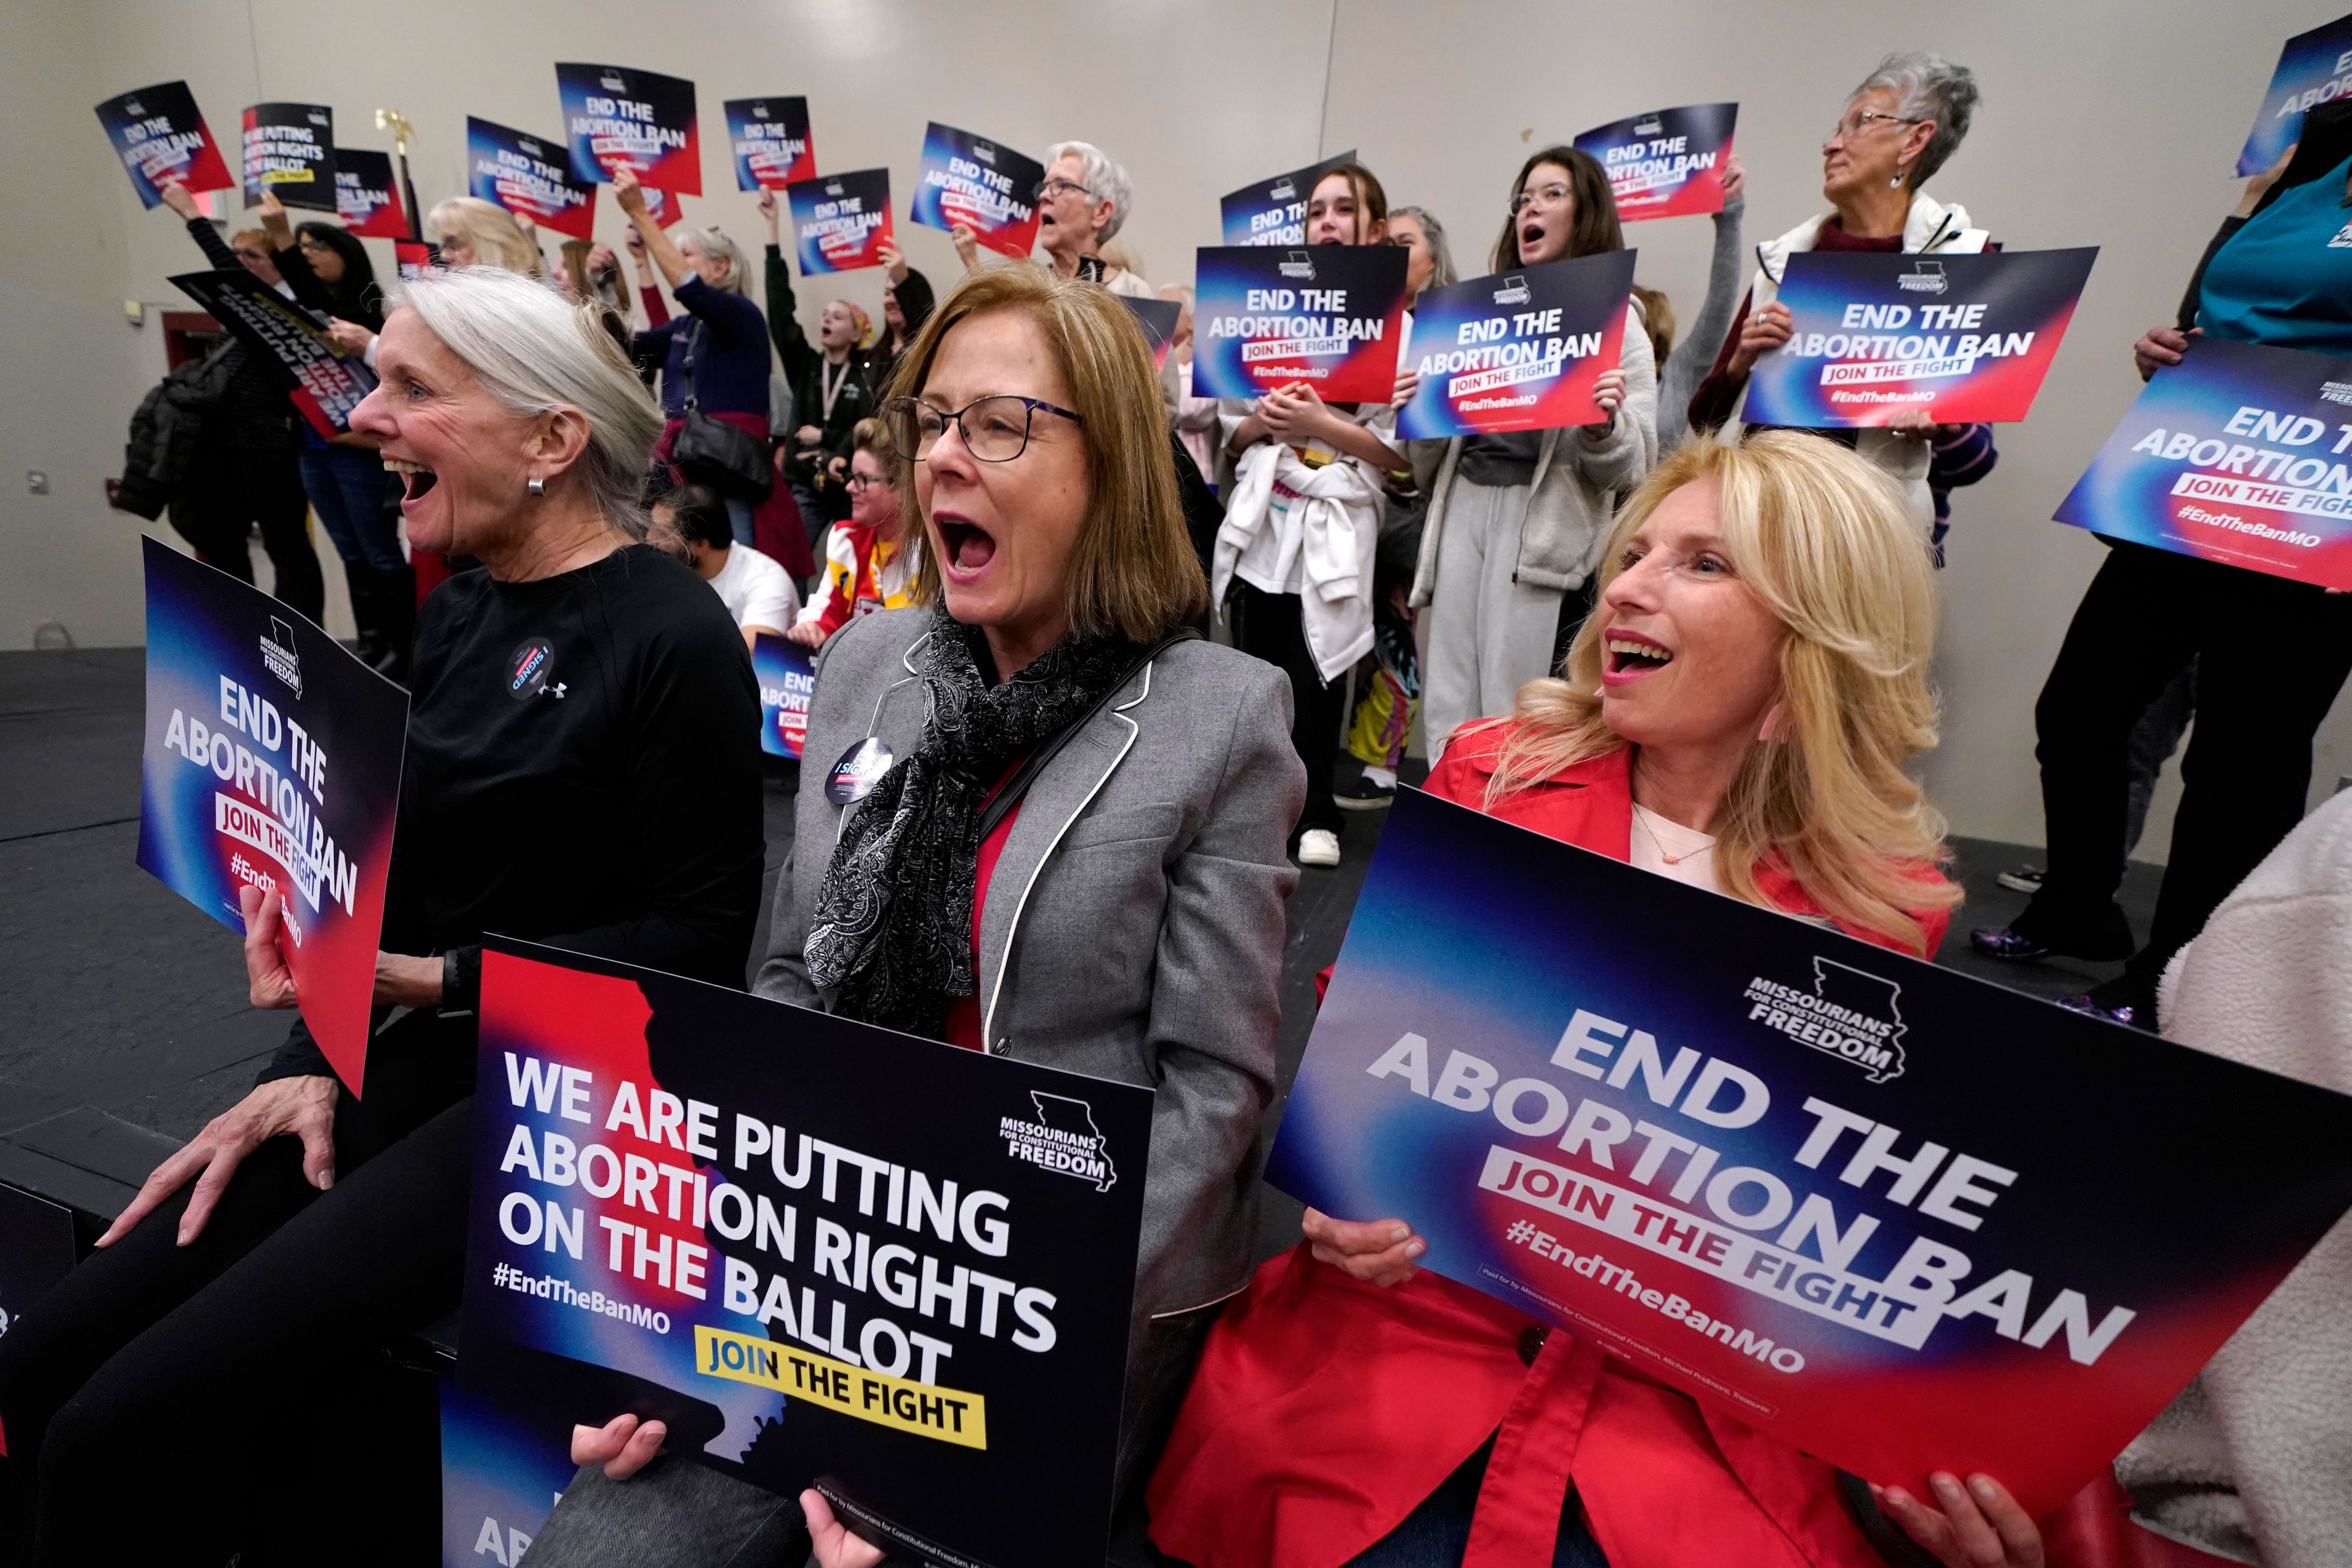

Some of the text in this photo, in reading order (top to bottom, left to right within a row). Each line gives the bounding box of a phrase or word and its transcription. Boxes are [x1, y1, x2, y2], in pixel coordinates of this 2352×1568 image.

[586, 97, 654, 123] END THE
[169, 130, 205, 151] BAN
[572, 117, 686, 149] ABORTION BAN
[764, 123, 786, 138] THE
[780, 139, 806, 154] BAN
[497, 149, 564, 183] END THE
[1607, 137, 1687, 164] END THE
[1607, 153, 1716, 180] ORTION BAN
[949, 157, 1013, 194] END THE
[355, 189, 390, 205] BAN
[554, 184, 586, 206] BAN
[815, 197, 862, 219] END THE
[925, 170, 998, 206] ABORTION
[997, 195, 1032, 222] BAN
[856, 211, 883, 228] BAN
[1251, 200, 1309, 233] END TH
[1247, 289, 1347, 312] END THE
[1841, 304, 1988, 330] END THE
[1208, 316, 1384, 341] ABORTION BAN
[1457, 308, 1562, 345] END THE
[1248, 339, 1342, 358] JOIN THE FIGHT
[1417, 332, 1601, 378] ABORTION BAN
[1781, 331, 2034, 359] ABORTION BAN
[285, 338, 353, 410] BORTION
[1254, 366, 1328, 378] #EndTheBanMO
[1454, 362, 1554, 393] JOIN THE FIGHT
[1828, 359, 1967, 381] JOIN THE FIGHT
[1458, 394, 1536, 412] #EndTheBanMO
[1831, 390, 1936, 404] #EndTheBanMO
[2223, 407, 2325, 446] END
[2182, 478, 2239, 498] JOIN
[2245, 486, 2297, 506] THE
[2178, 505, 2321, 548] #EndTheBanMO
[260, 635, 296, 666] MISSOURIANS
[268, 649, 296, 674] CONSTITUTIONAL
[265, 654, 298, 689] FREEDOM
[513, 652, 543, 690] SIGNED
[761, 687, 810, 712] ABORT
[783, 715, 801, 724] JOIN
[220, 674, 327, 805] END THE
[835, 763, 842, 773] I
[165, 708, 358, 917] ABORTION BAN
[223, 802, 318, 897] JOIN THE FIGHT
[1743, 989, 1883, 1047] FOR CONSTITUTIONAL
[1749, 977, 1893, 1037] MISSOURIANS
[1749, 1003, 1893, 1069] FREEDOM
[1000, 1117, 1097, 1150] MISSOURIANS
[1550, 1009, 2018, 1231] END THE
[503, 1051, 1009, 1256] WE ARE PUTTING
[1000, 1129, 1096, 1159] FOR CONSTITUTIONAL
[1009, 1140, 1105, 1178] FREEDOM
[1367, 1031, 2137, 1366] ABORTION BAN
[501, 1125, 1057, 1353] ABORTION RIGHTS
[1498, 1161, 1917, 1329] JOIN THE FIGHT
[493, 1263, 671, 1334] #EndTheBanMO
[499, 1193, 952, 1387] ON THE BALLOT
[1507, 1219, 1804, 1375] #EndTheBanMO
[1483, 1268, 1499, 1279] Paid
[1498, 1275, 1510, 1284] for
[1510, 1279, 1520, 1290] by
[1520, 1286, 1562, 1310] Missourians
[1562, 1305, 1574, 1315] for
[1575, 1313, 1626, 1341] Constitutional
[1663, 1355, 1694, 1376] Michael
[709, 1338, 968, 1433] JOIN THE FIGHT
[817, 1485, 829, 1496] Paid
[839, 1498, 846, 1508] by
[846, 1502, 881, 1528] Missourians
[882, 1521, 891, 1532] for
[892, 1528, 936, 1555] Constitutional
